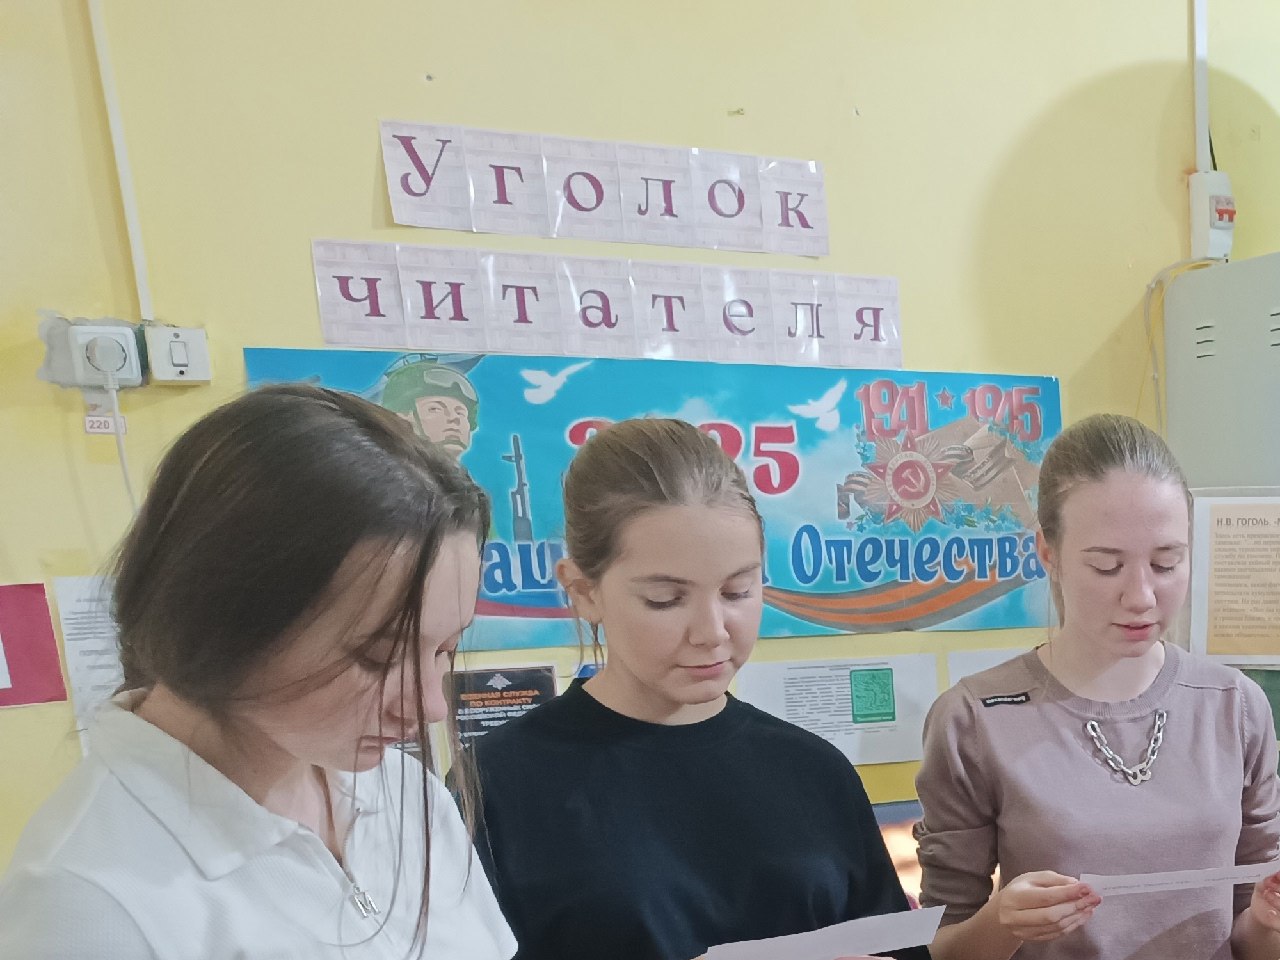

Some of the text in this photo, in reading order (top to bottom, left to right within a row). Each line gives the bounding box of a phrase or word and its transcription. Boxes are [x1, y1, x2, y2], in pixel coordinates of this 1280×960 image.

[393, 134, 813, 229] Уголок
[332, 275, 884, 343] читателя
[88, 420, 110, 430] 220
[855, 381, 1042, 444] 1941 1945
[790, 524, 1047, 583] Отечества
